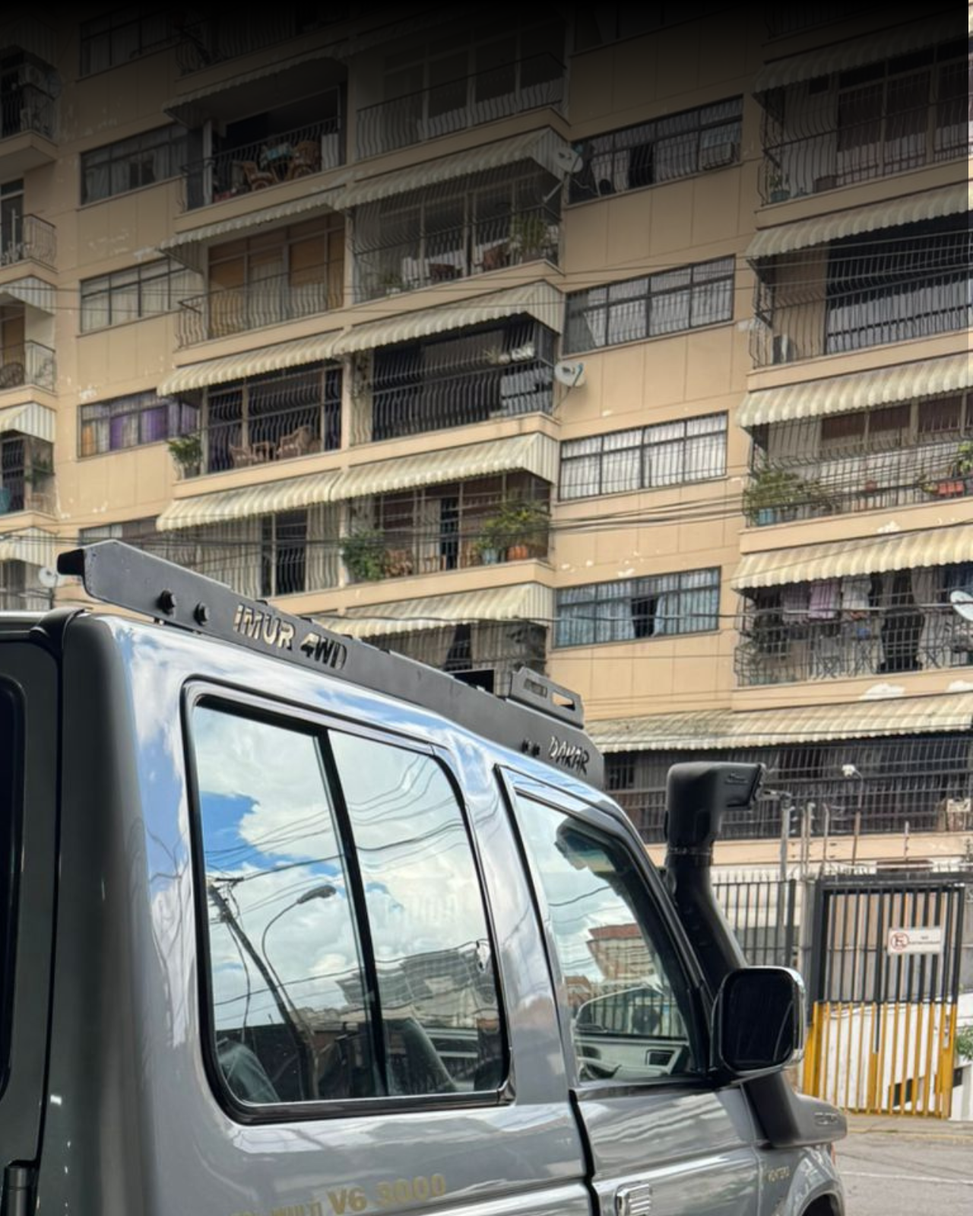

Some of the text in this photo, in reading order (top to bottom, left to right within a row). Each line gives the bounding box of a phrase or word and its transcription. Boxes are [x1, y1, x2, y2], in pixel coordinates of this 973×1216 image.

[299, 632, 348, 670] 4WD
[548, 736, 590, 775] DAKAR
[328, 1186, 368, 1216] V6
[376, 1173, 446, 1208] 3000
